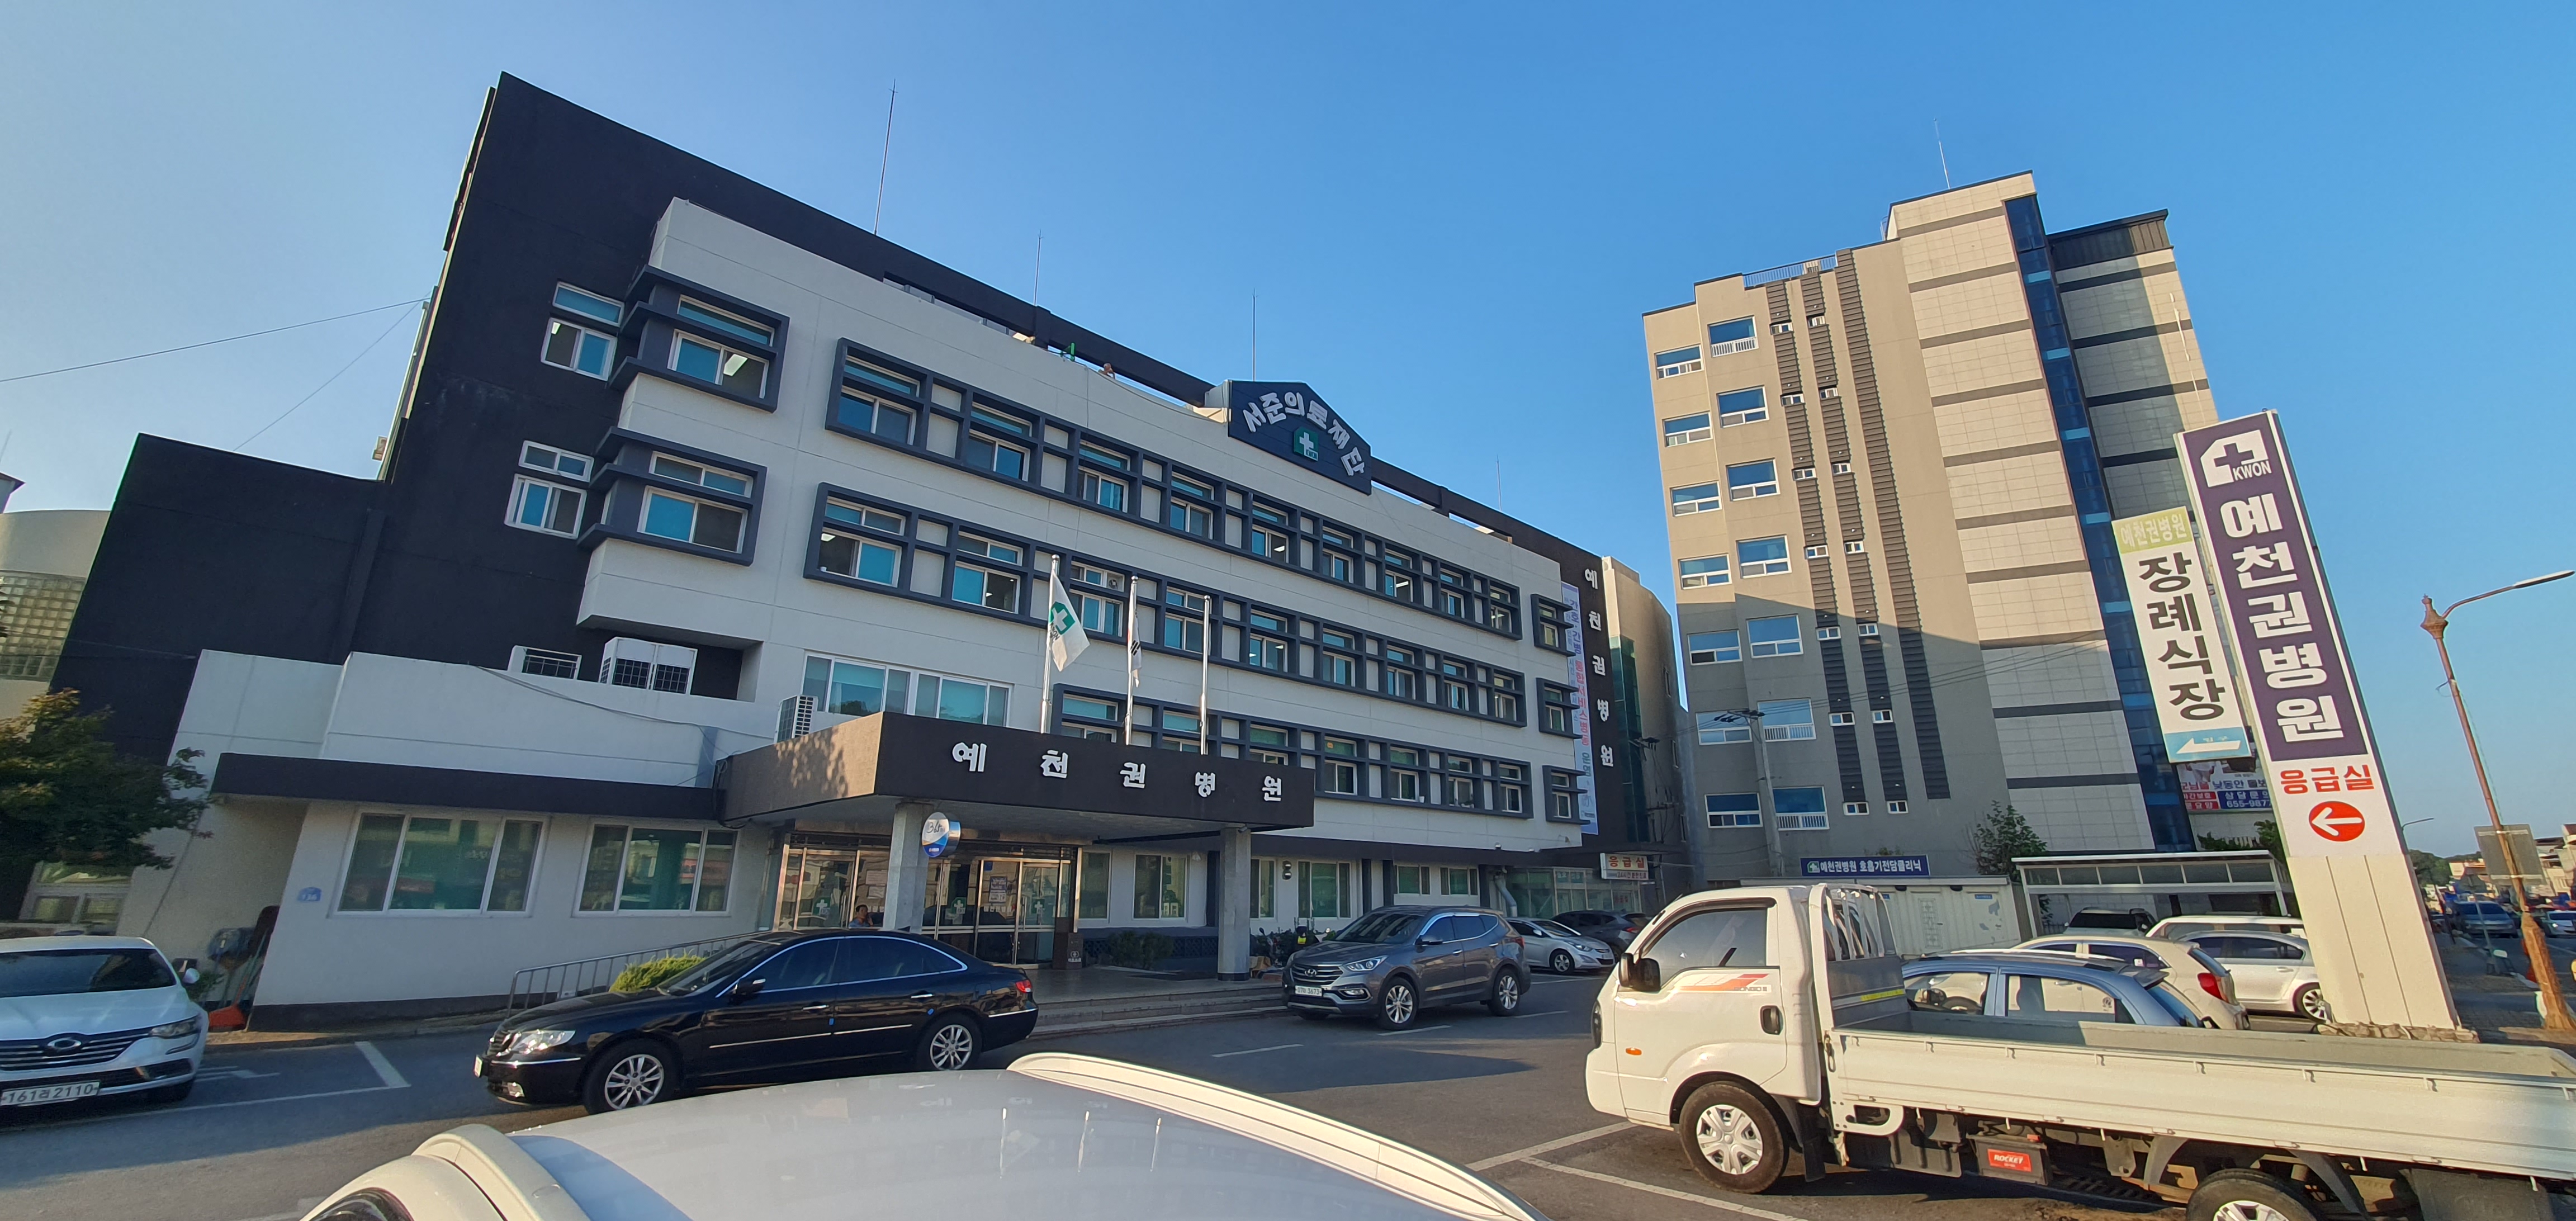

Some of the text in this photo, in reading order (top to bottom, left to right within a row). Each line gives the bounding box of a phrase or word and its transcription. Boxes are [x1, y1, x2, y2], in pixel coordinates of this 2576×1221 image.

[1243, 392, 1365, 476] 서준의료재단
[2232, 460, 2272, 481] KWON
[2120, 514, 2187, 548] 예천권병원
[2220, 493, 2344, 743] 예천권병원
[2138, 551, 2226, 721] 장례식장
[1584, 568, 1614, 767] 예천권병원
[951, 741, 1282, 802] 예천권병원
[2280, 764, 2375, 794] 응급실
[1608, 855, 1645, 868] 응급실
[1820, 859, 1922, 873] 예천권병원 호흡기전담클리닉
[1994, 1154, 2024, 1164] ROCKET
